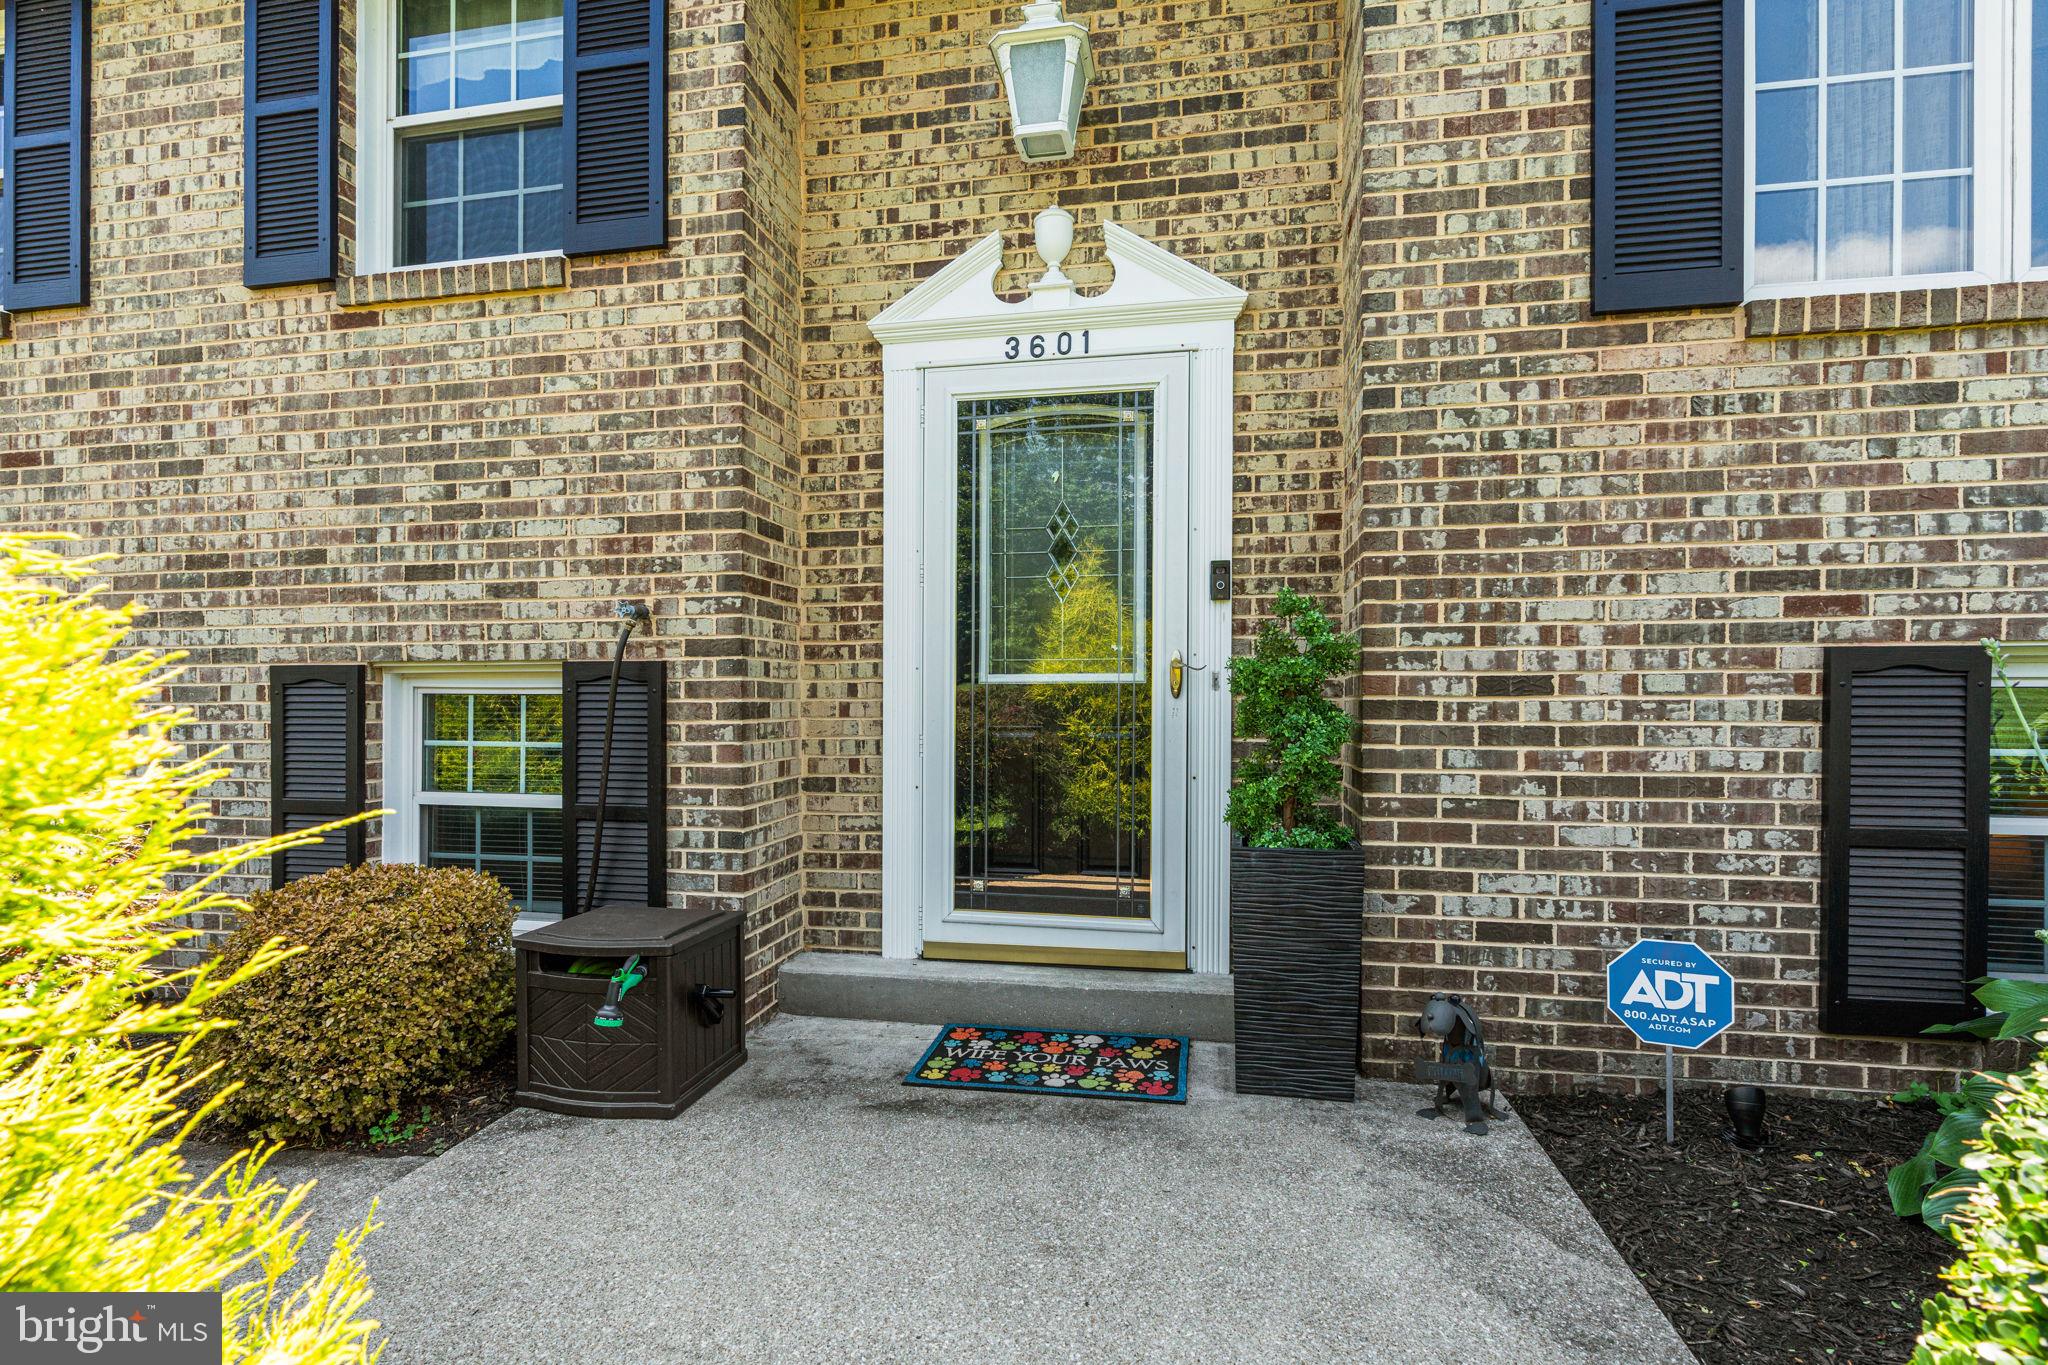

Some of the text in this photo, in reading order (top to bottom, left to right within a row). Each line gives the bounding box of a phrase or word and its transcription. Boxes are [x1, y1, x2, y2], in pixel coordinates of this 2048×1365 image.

[1005, 329, 1089, 360] 3601
[1641, 957, 1683, 968] SECURED
[1620, 969, 1720, 1013] ADT
[1623, 1009, 1716, 1028] 800.ADT.ASAP
[1648, 1023, 1691, 1034] ADT.COM
[946, 1047, 1169, 1071] WIPE YOUR PAWS
